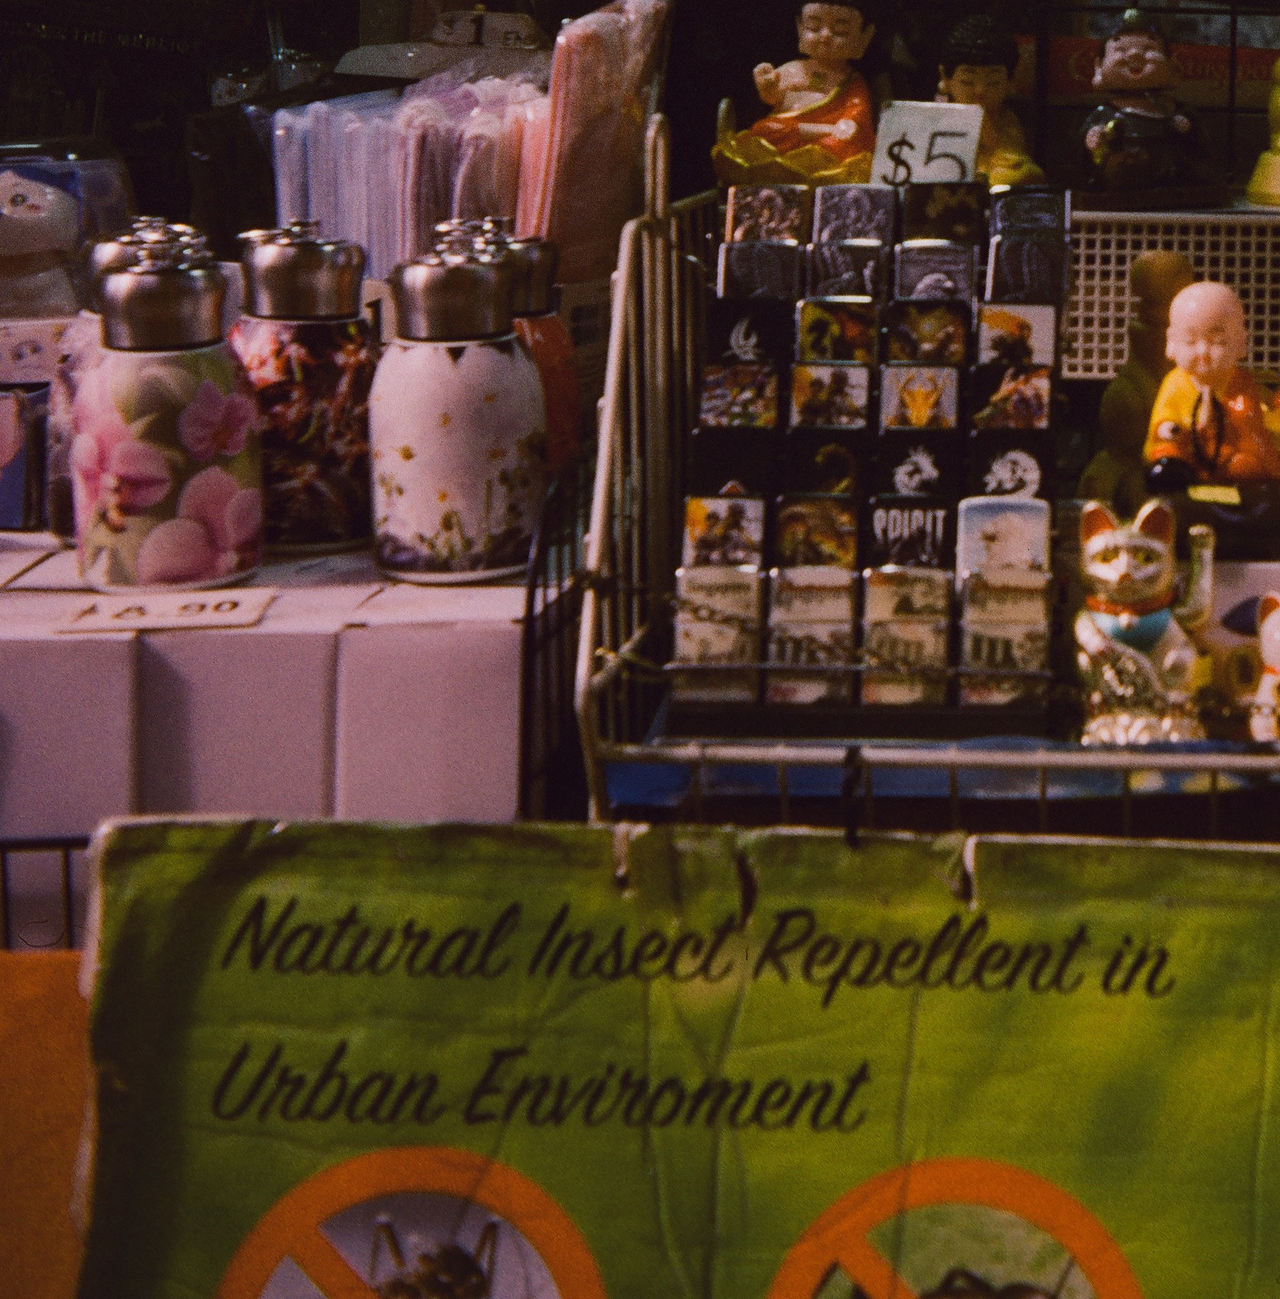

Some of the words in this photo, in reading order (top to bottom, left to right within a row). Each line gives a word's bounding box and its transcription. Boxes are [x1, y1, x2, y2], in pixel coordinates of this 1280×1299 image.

[880, 130, 968, 187] $5
[221, 895, 522, 980] Natural
[528, 903, 737, 985] Insect
[753, 908, 1091, 1009] Repellent
[1102, 933, 1177, 1000] in
[211, 1040, 449, 1128] Urban
[463, 1044, 872, 1134] Enviroment
